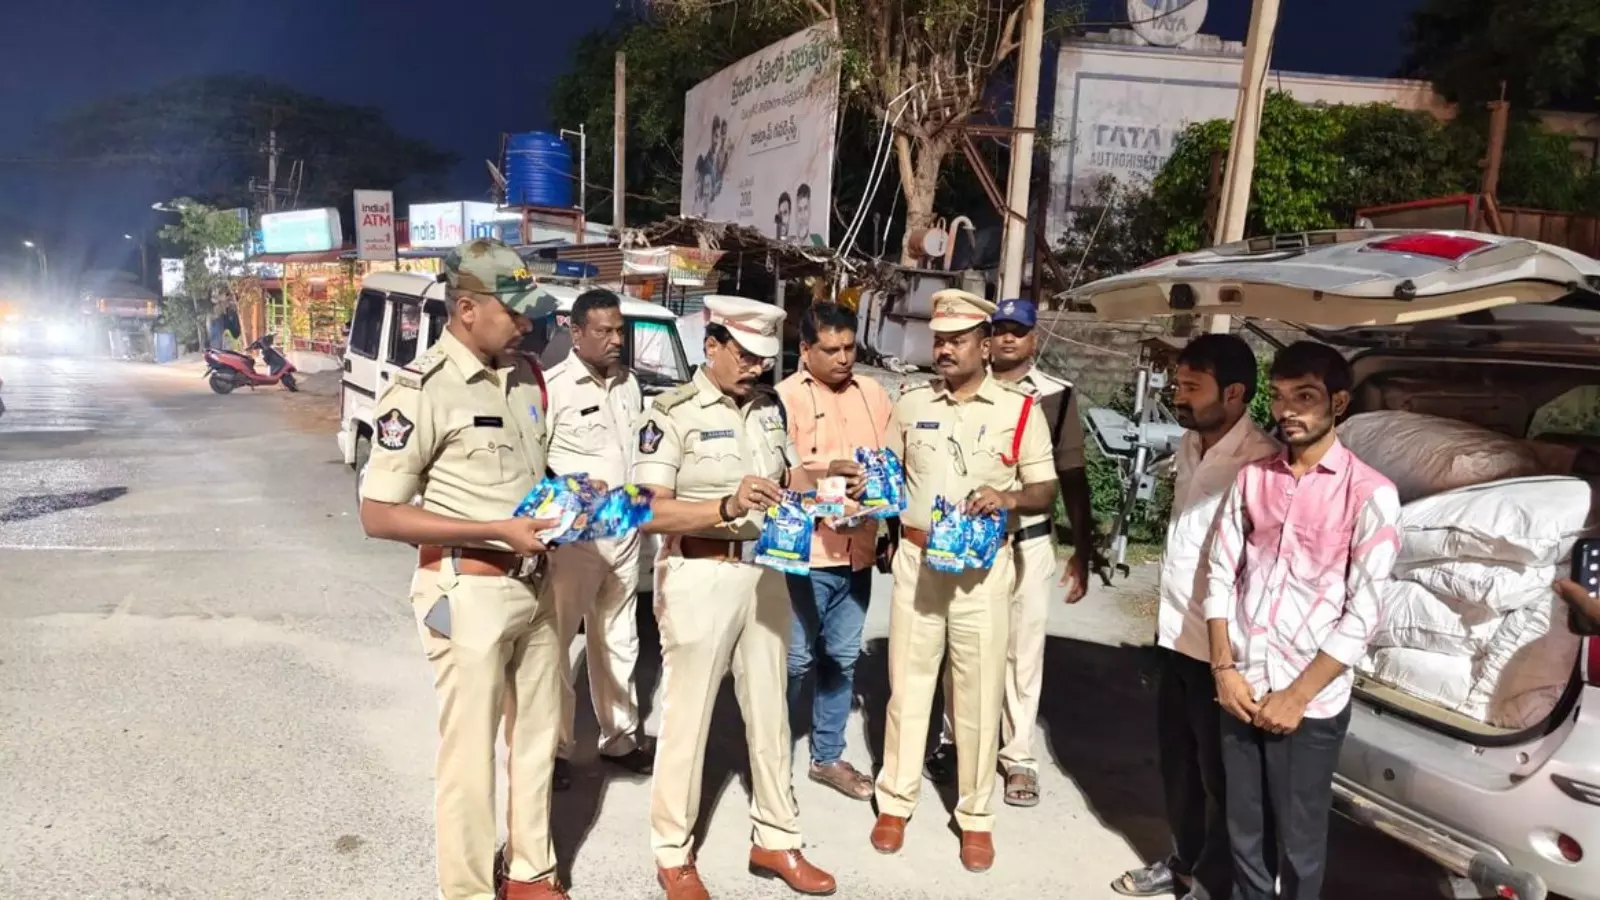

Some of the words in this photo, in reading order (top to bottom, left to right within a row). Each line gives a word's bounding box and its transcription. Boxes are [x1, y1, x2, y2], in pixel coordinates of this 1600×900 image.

[1151, 16, 1188, 32] TATA
[1093, 123, 1161, 149] TATA
[363, 214, 391, 227] ATM
